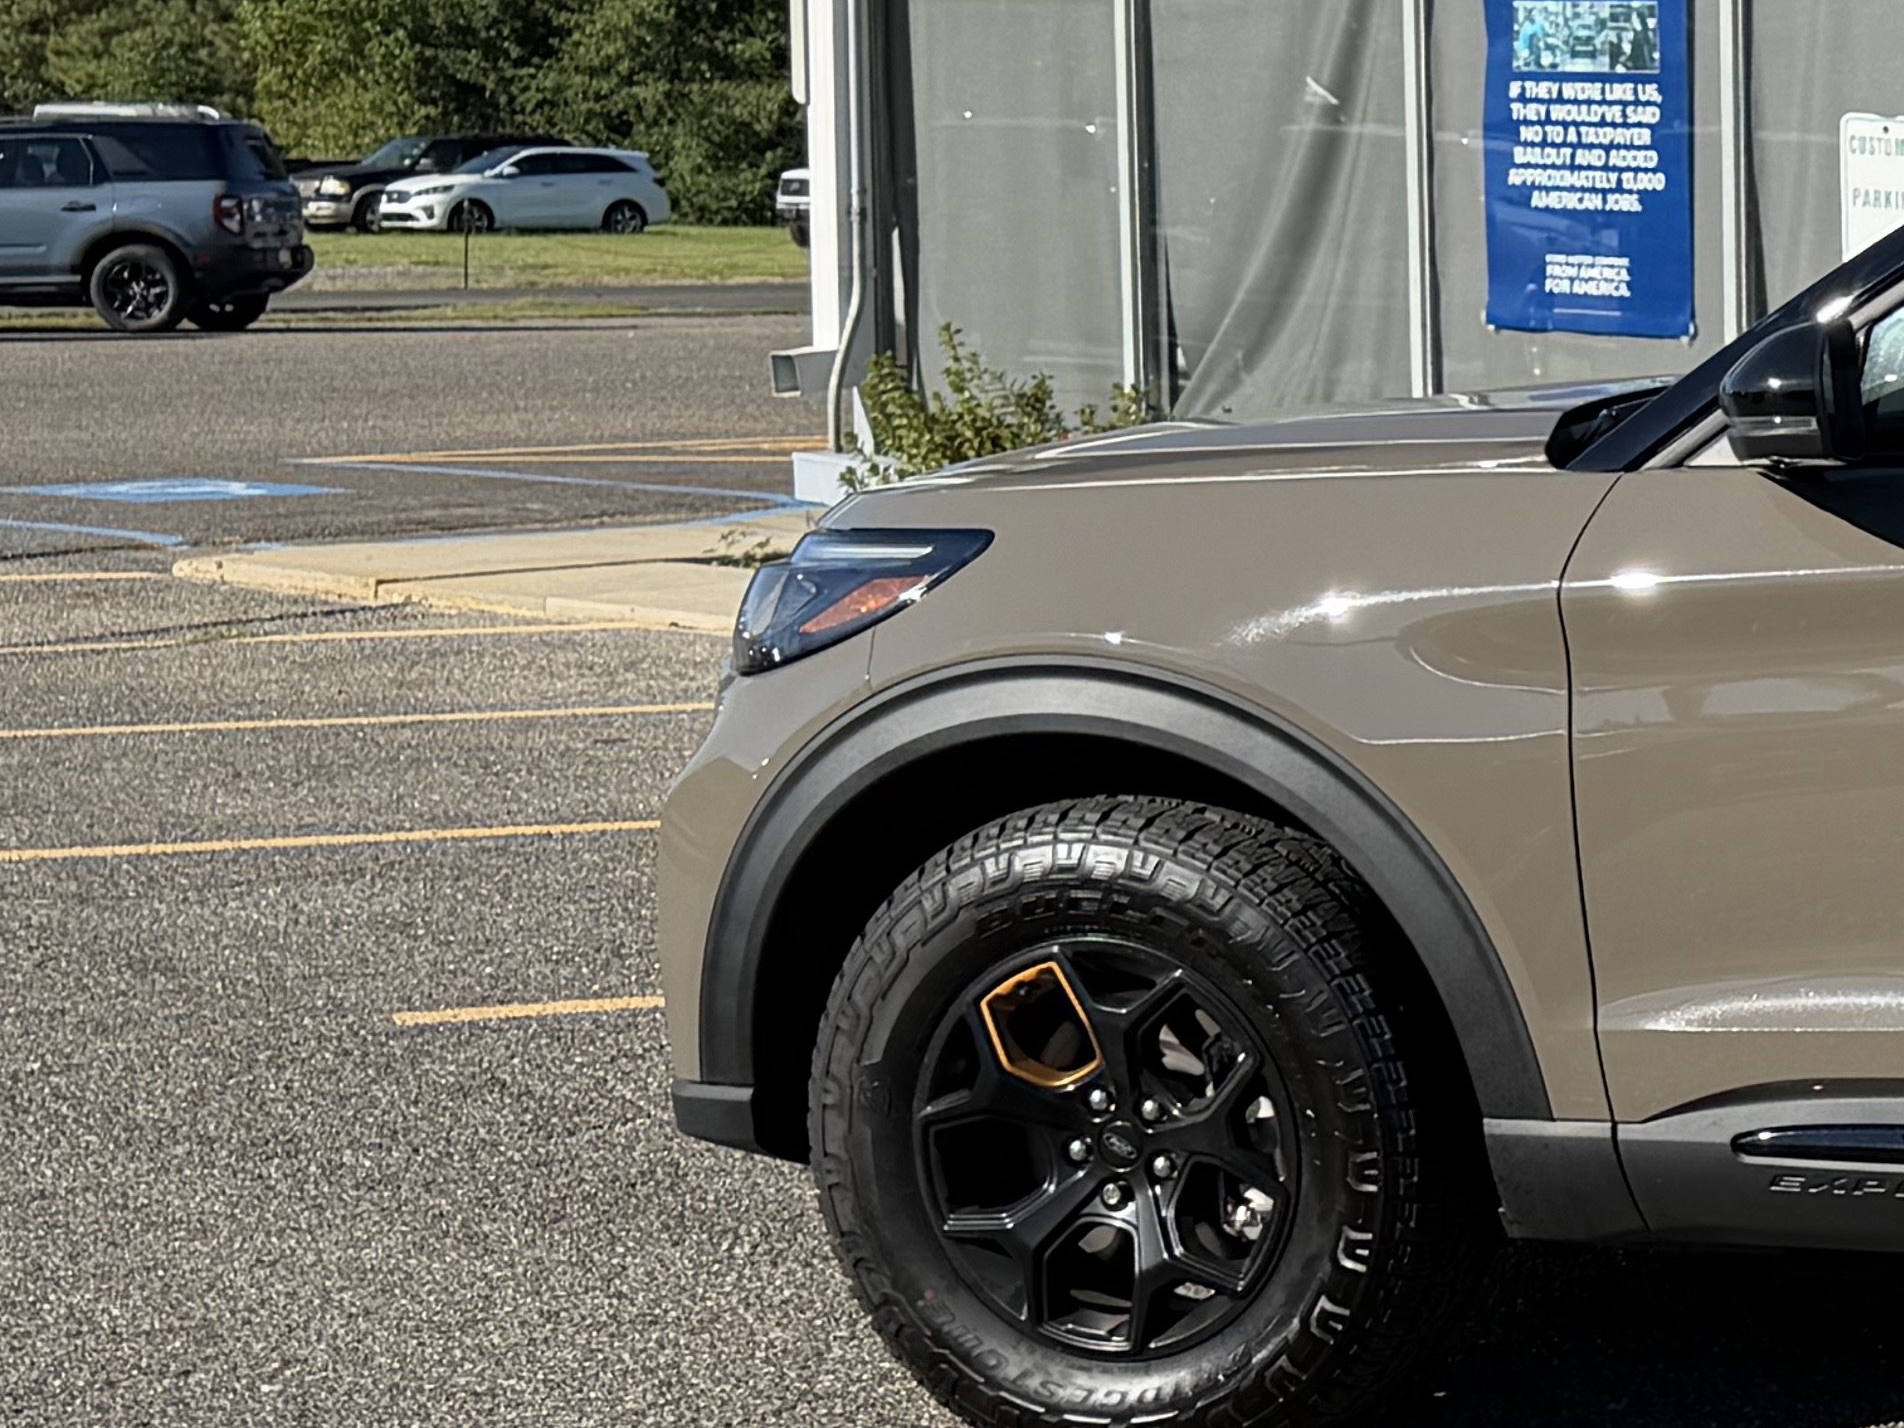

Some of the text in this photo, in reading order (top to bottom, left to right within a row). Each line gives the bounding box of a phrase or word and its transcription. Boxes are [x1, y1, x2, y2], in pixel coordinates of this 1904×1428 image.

[1508, 80, 1663, 103] IF THEY WERE LIKE US,
[1510, 102, 1661, 124] THEY WOULD'VE SAID
[1519, 125, 1651, 145] NO TO A TAXPAYER
[1513, 146, 1658, 168] BAILOUT AND ADDED
[1507, 168, 1618, 189] APPROXIMATELY
[1530, 190, 1603, 210] AMERICAN
[1544, 277, 1571, 294] FOR
